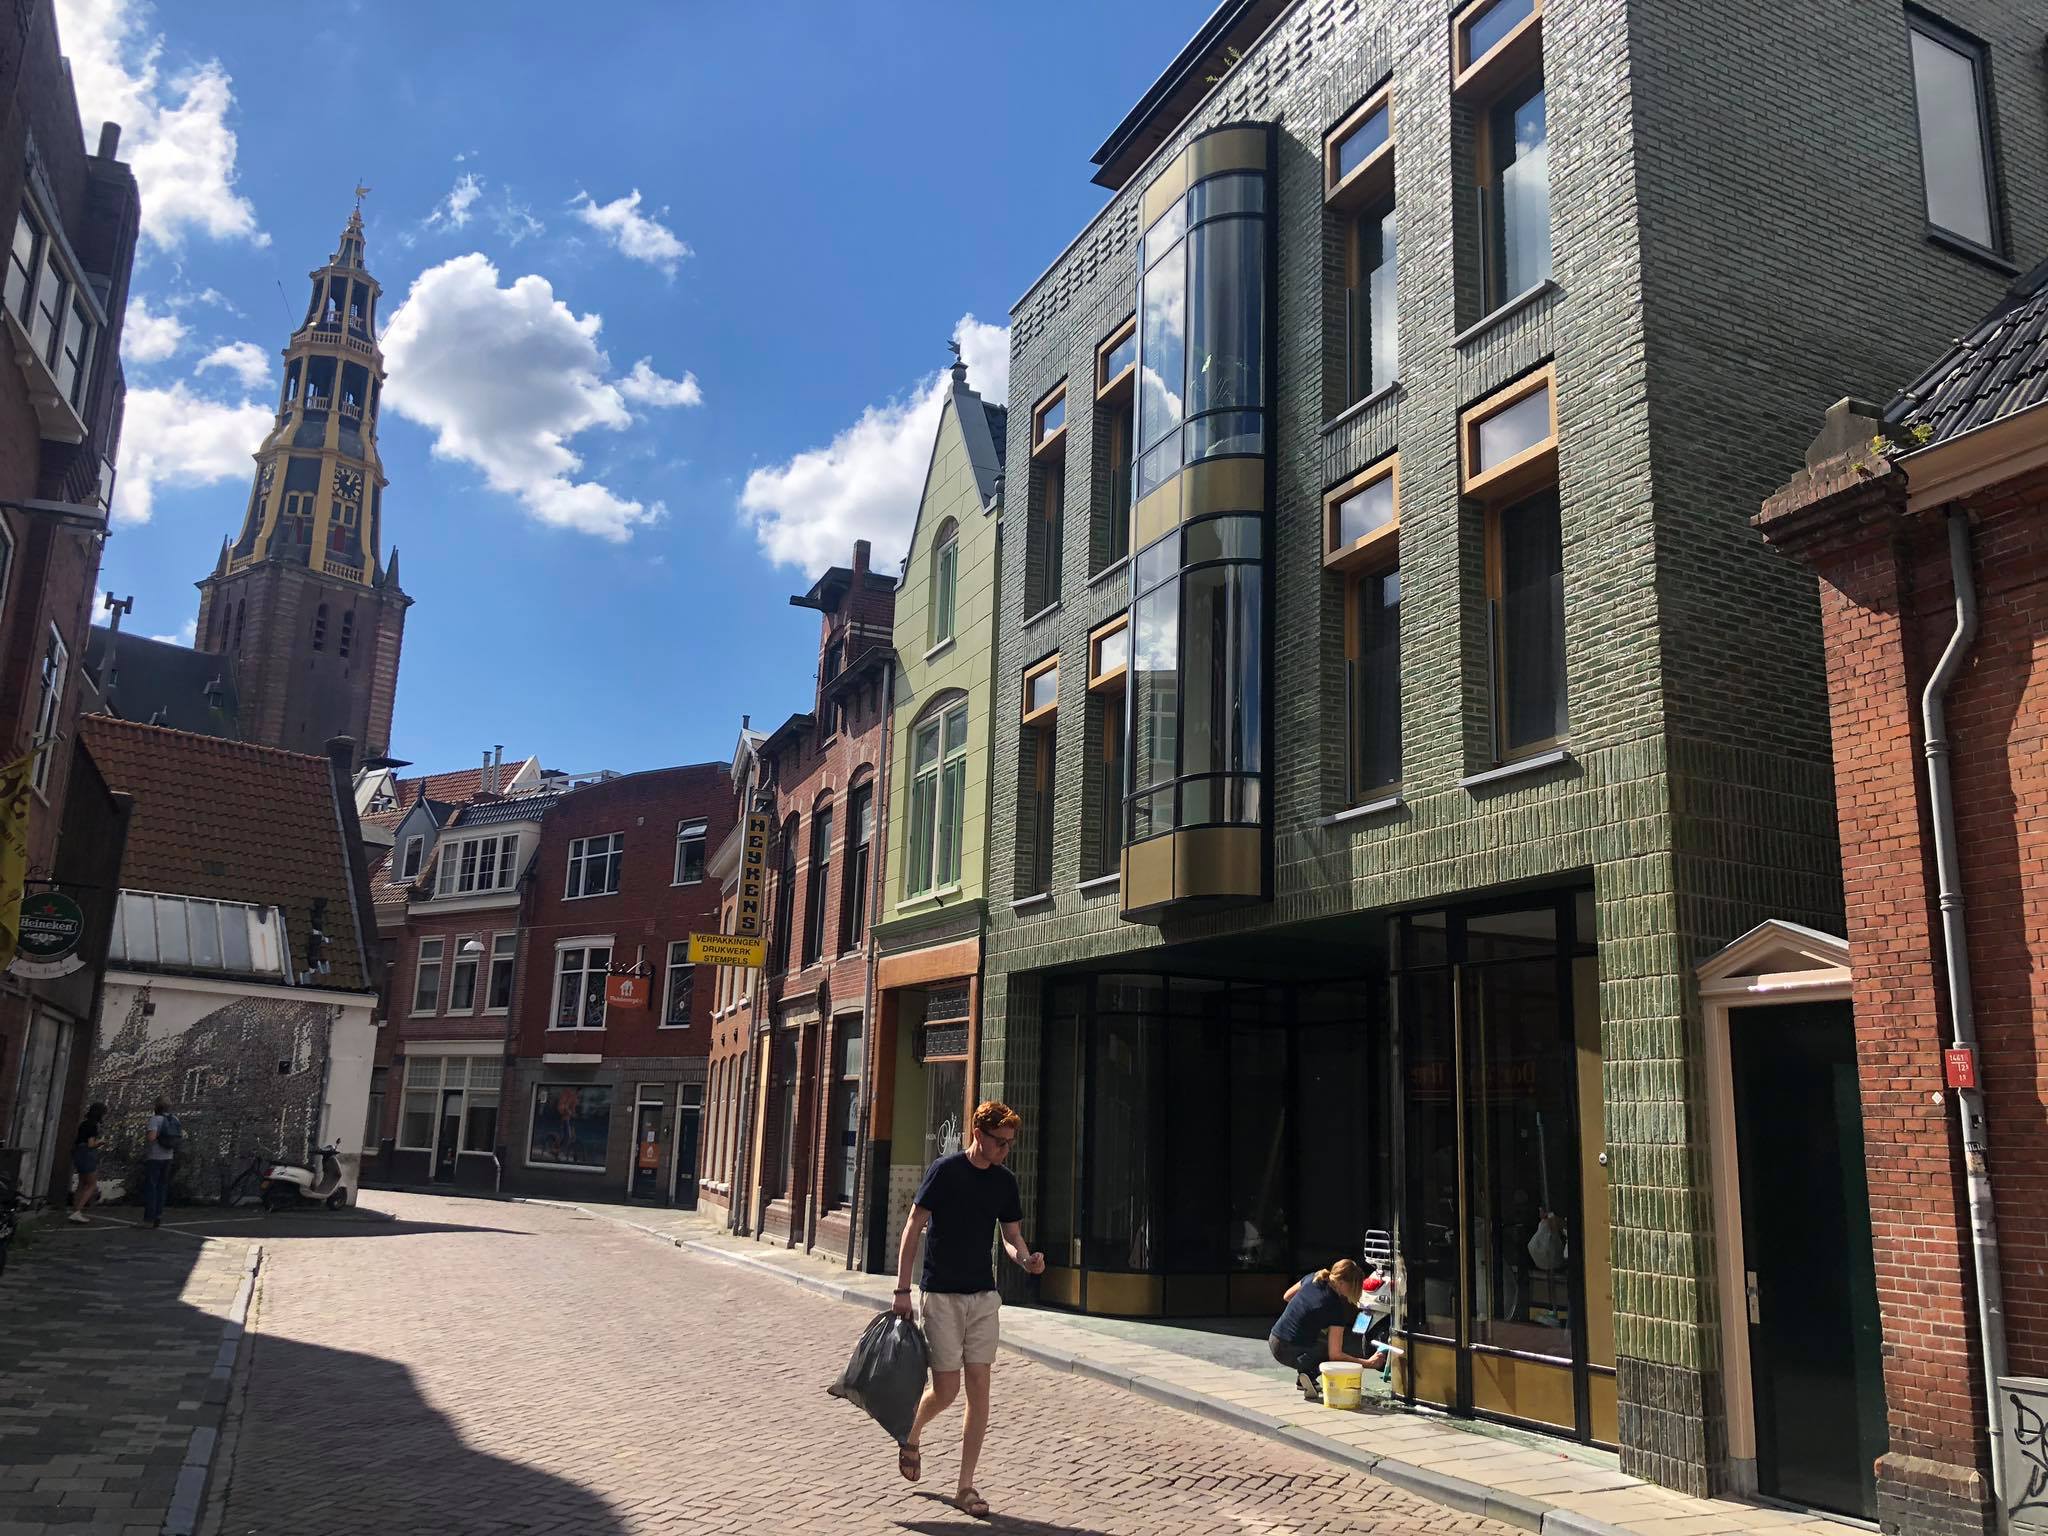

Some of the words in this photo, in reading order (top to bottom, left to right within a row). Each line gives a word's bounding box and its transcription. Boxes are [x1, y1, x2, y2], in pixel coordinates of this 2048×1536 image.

[742, 819, 765, 930] HEYKENS
[20, 918, 73, 931] Heineken
[696, 935, 761, 947] VERPAKKINGEN
[702, 945, 751, 956] DRUKWERK
[703, 955, 748, 965] STEMPELS
